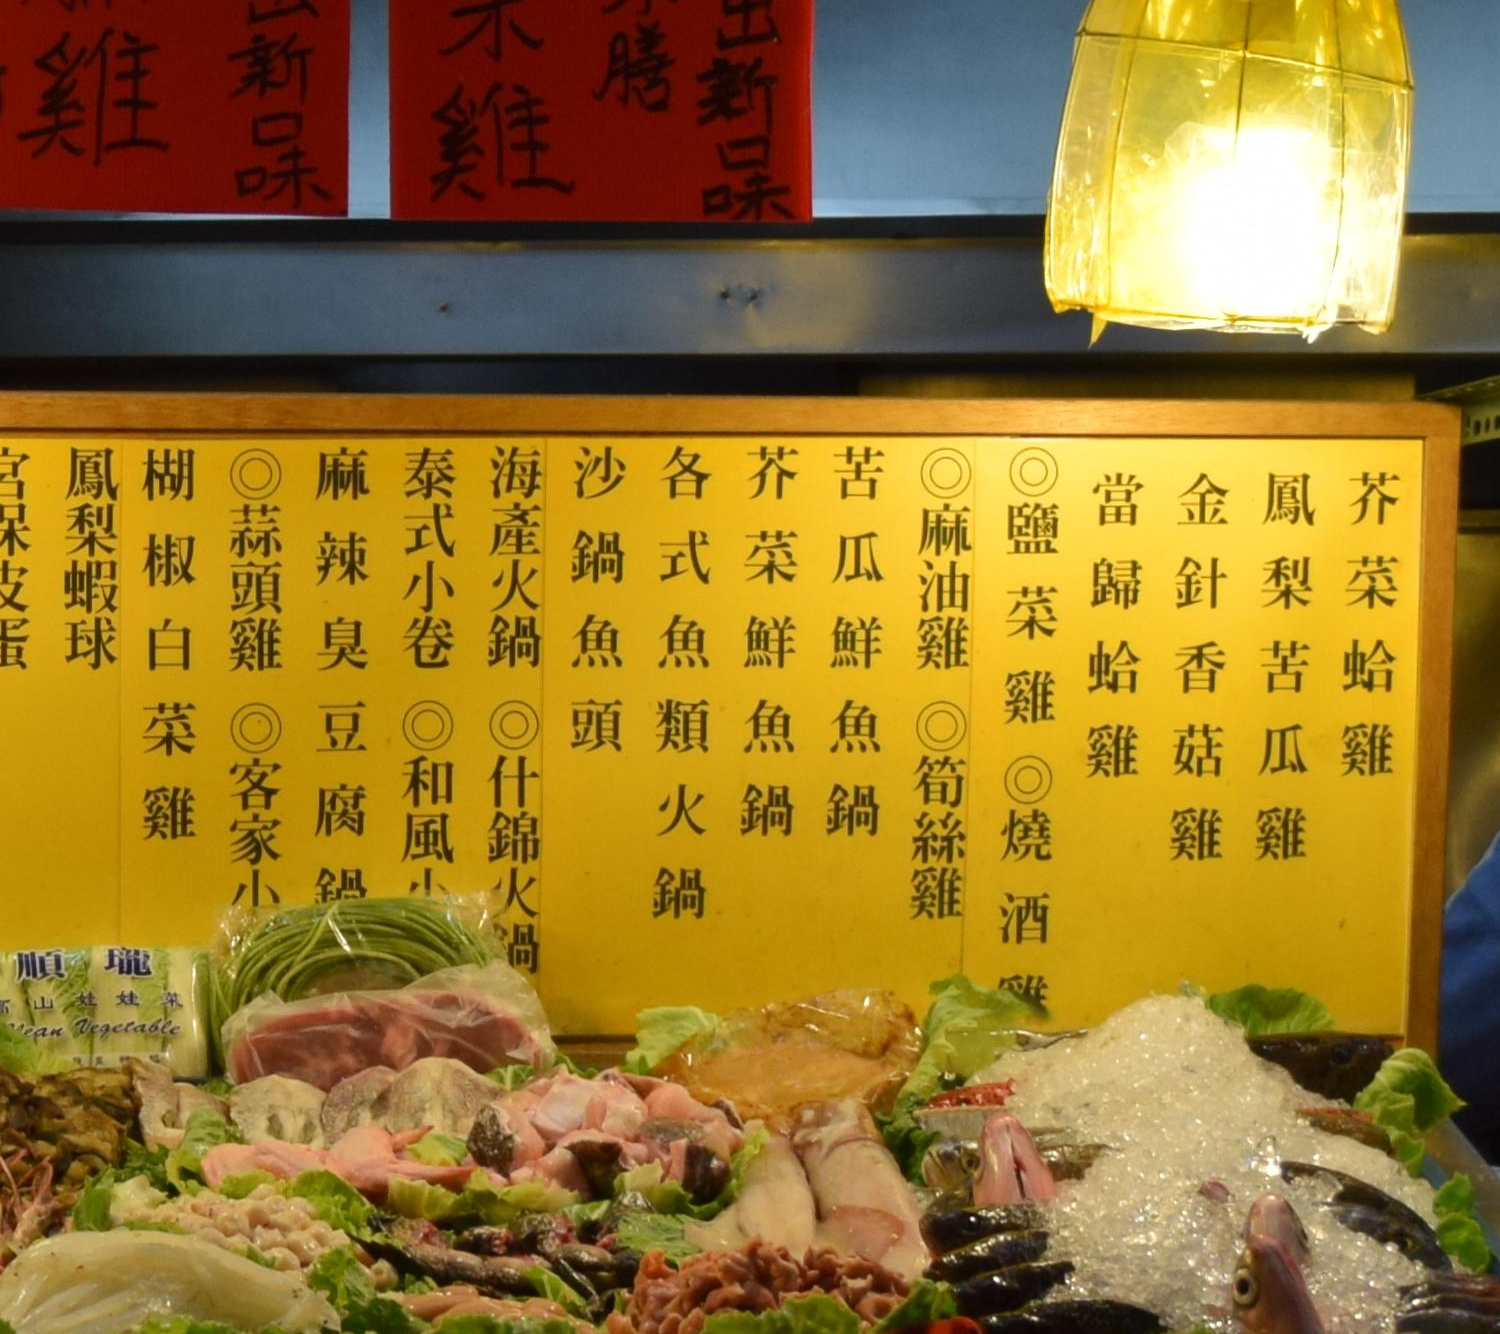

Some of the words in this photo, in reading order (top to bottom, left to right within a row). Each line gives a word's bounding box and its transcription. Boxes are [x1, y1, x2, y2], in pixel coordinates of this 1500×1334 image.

[63, 446, 119, 670] 鳳梨蝦球
[314, 447, 370, 904] 麻辣臭豆腐鍋
[402, 446, 454, 670] 泰式小卷
[487, 446, 541, 669] 海產火鍋
[570, 446, 626, 753] 沙鍋魚頭
[651, 446, 712, 920] 各式魚類火鍋
[739, 446, 801, 839] 芥菜鮮魚鍋
[825, 446, 887, 839] 苦瓜鮮魚鍋
[915, 504, 973, 672] 麻油雞
[1086, 473, 1145, 780] 當歸蛤雞
[1169, 473, 1230, 861] 金針香菇雞
[1256, 471, 1318, 861] 鳳梨苦瓜雞
[1341, 471, 1401, 780] 芥菜蛤雞
[909, 755, 967, 922] 筍絲雞
[75, 1016, 181, 1037] Vegetable
